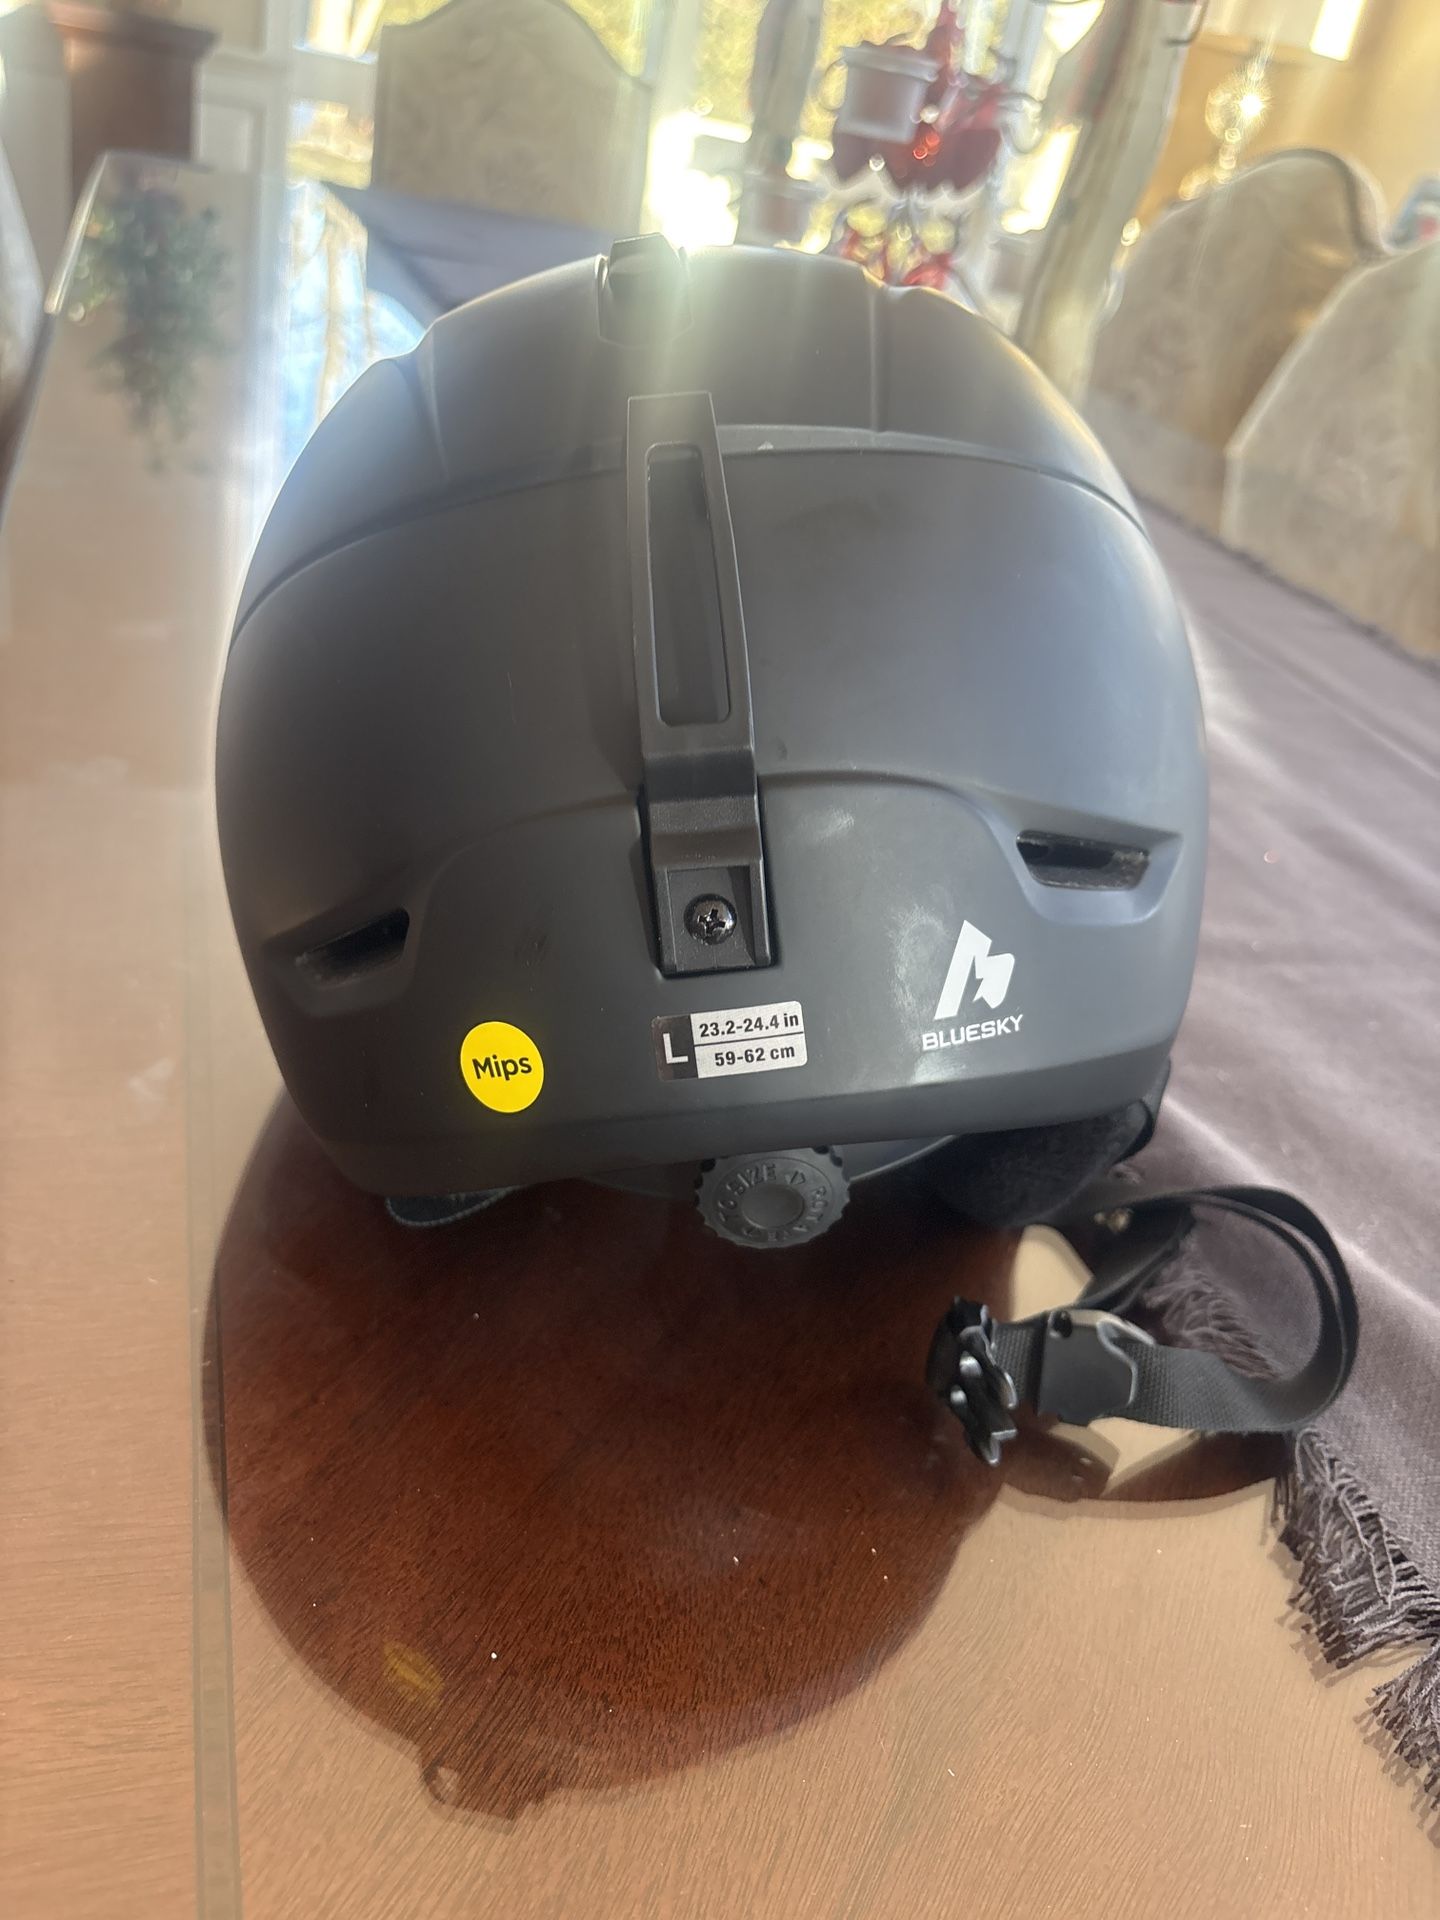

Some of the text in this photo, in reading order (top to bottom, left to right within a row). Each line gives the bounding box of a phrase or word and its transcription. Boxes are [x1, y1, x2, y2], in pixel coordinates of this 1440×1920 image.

[700, 1012, 799, 1038] 23.2-24.4 in
[922, 1013, 1024, 1051] BLUESKY
[662, 1032, 689, 1065] L
[714, 1045, 795, 1067] 59-62 cm
[472, 1054, 533, 1081] Mips
[725, 1163, 777, 1196] SIZE
